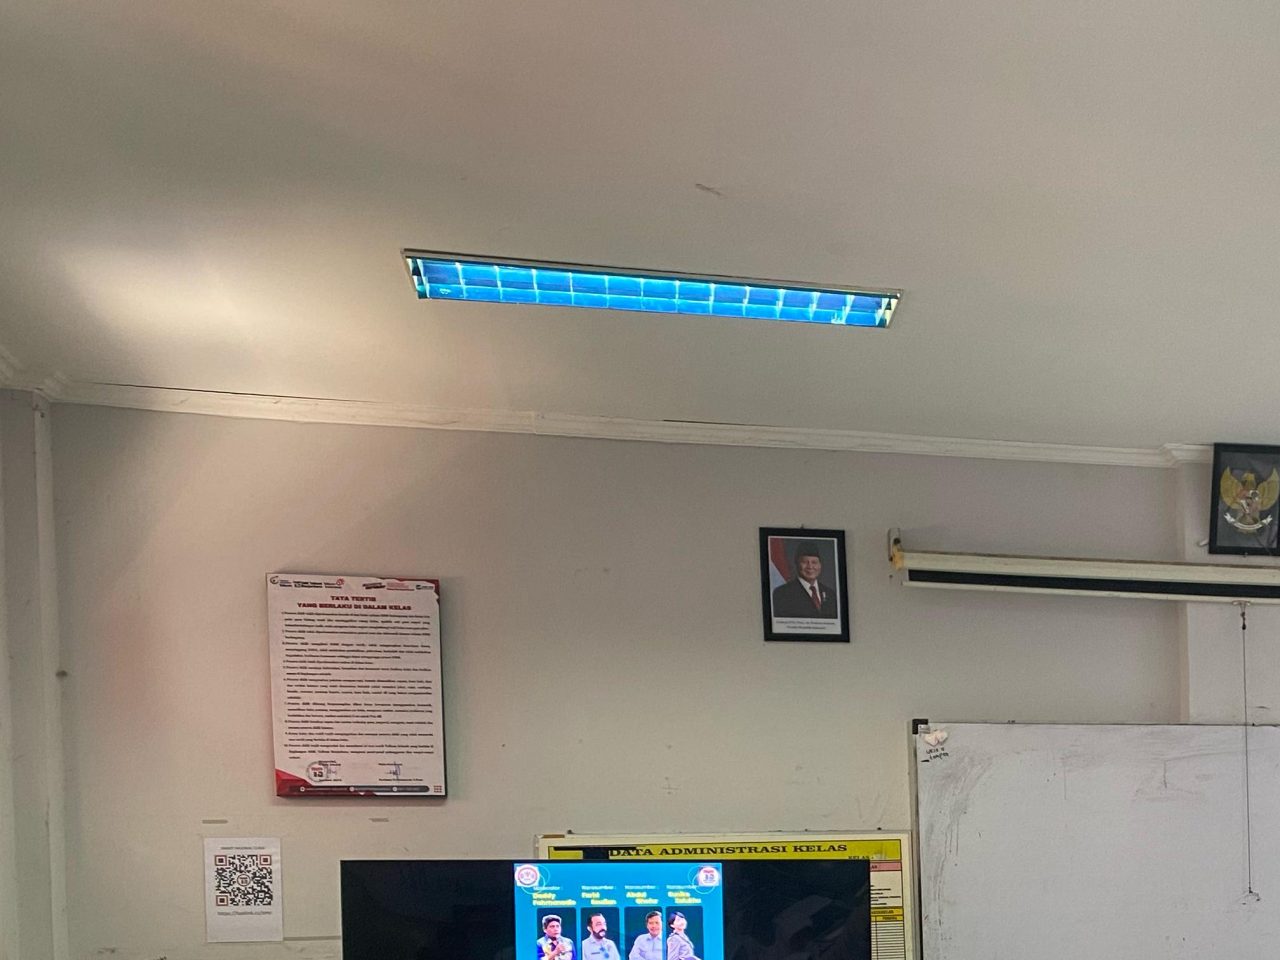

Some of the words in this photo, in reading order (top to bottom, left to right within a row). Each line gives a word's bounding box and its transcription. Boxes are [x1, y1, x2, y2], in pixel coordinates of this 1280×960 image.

[609, 848, 652, 858] DATA
[658, 845, 787, 857] ADMINISTRASI
[792, 843, 848, 853] KELAS
